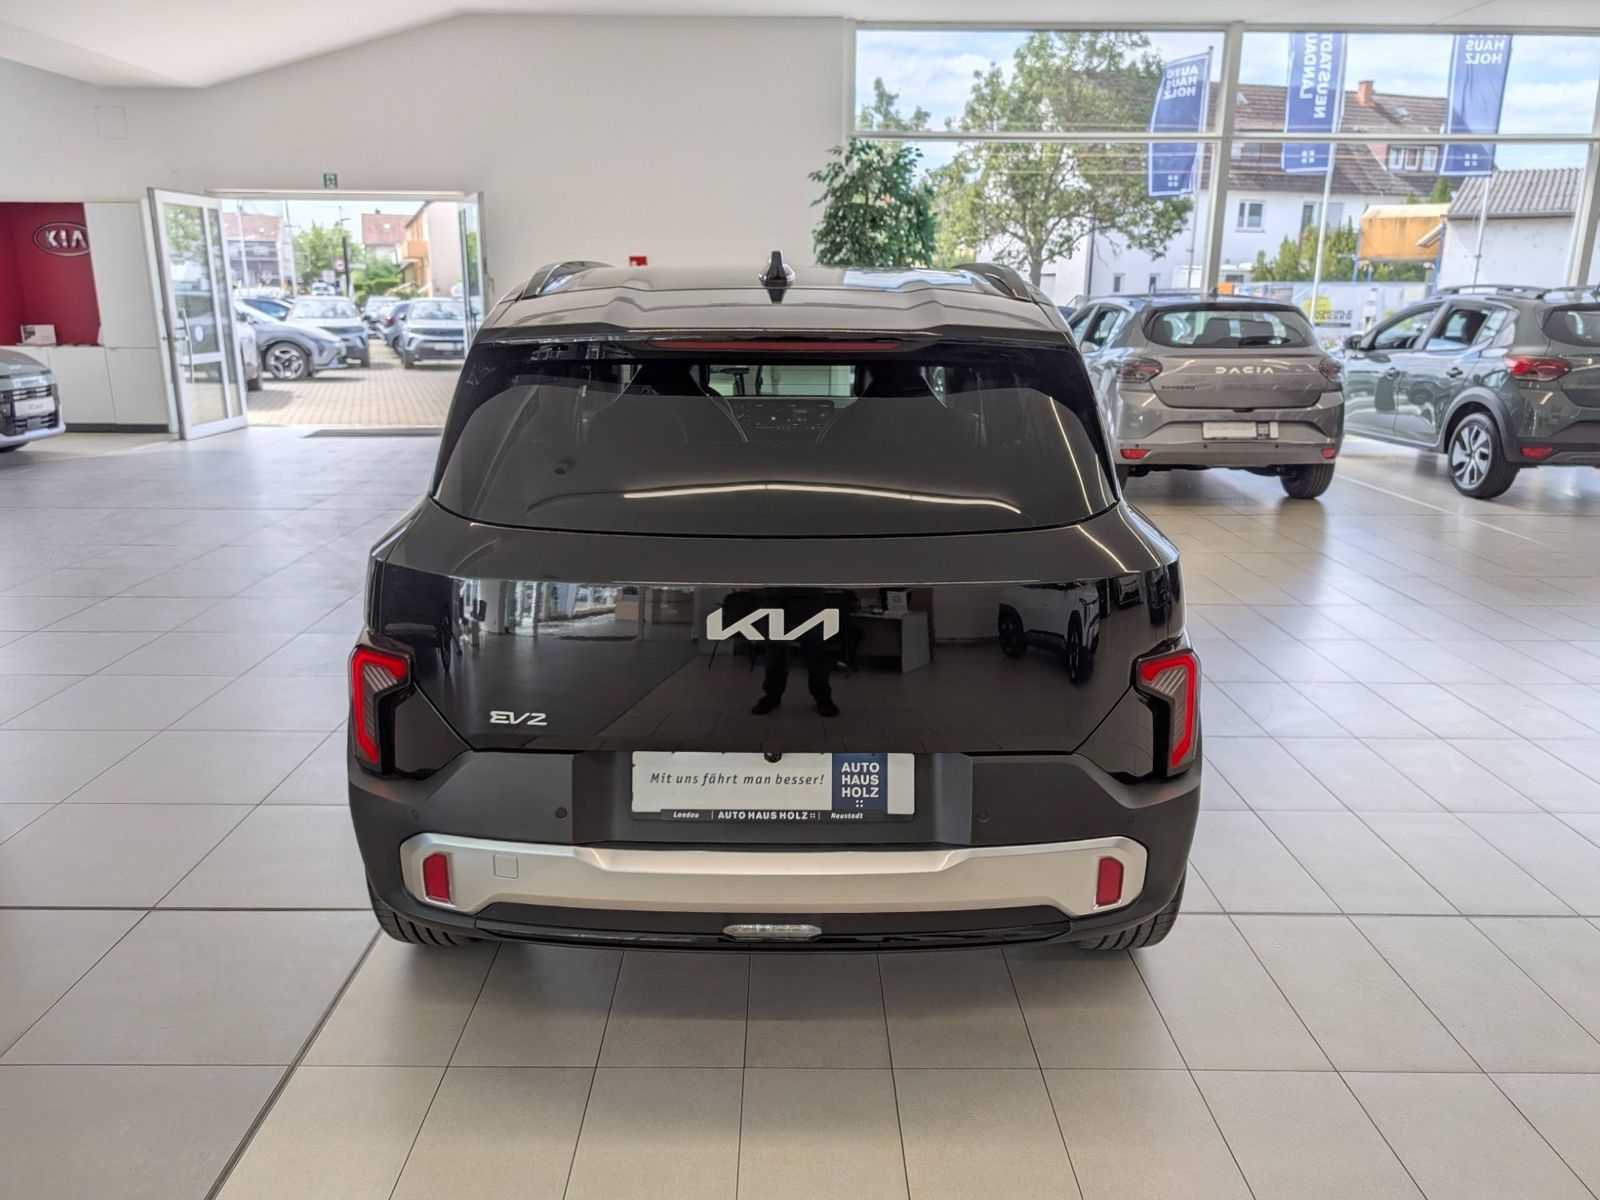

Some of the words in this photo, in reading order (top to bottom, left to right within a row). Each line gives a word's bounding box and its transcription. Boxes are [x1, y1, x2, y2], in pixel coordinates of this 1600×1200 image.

[45, 229, 88, 249] KIA
[1215, 366, 1274, 375] DACIA
[706, 607, 840, 641] KIA
[490, 710, 548, 726] EV2
[841, 762, 880, 773] AUTO
[650, 773, 673, 785] Mit
[676, 774, 699, 785] uns
[700, 772, 739, 787] fährt
[743, 774, 771, 785] man
[775, 773, 825, 785] besser!
[841, 774, 880, 785] HAUS
[841, 787, 880, 798] HOLZ
[673, 811, 700, 819] Landau
[717, 811, 746, 820] AUTO
[748, 811, 777, 820] HAUS
[779, 811, 808, 820] HOLZ
[830, 812, 864, 820] Neustadt
